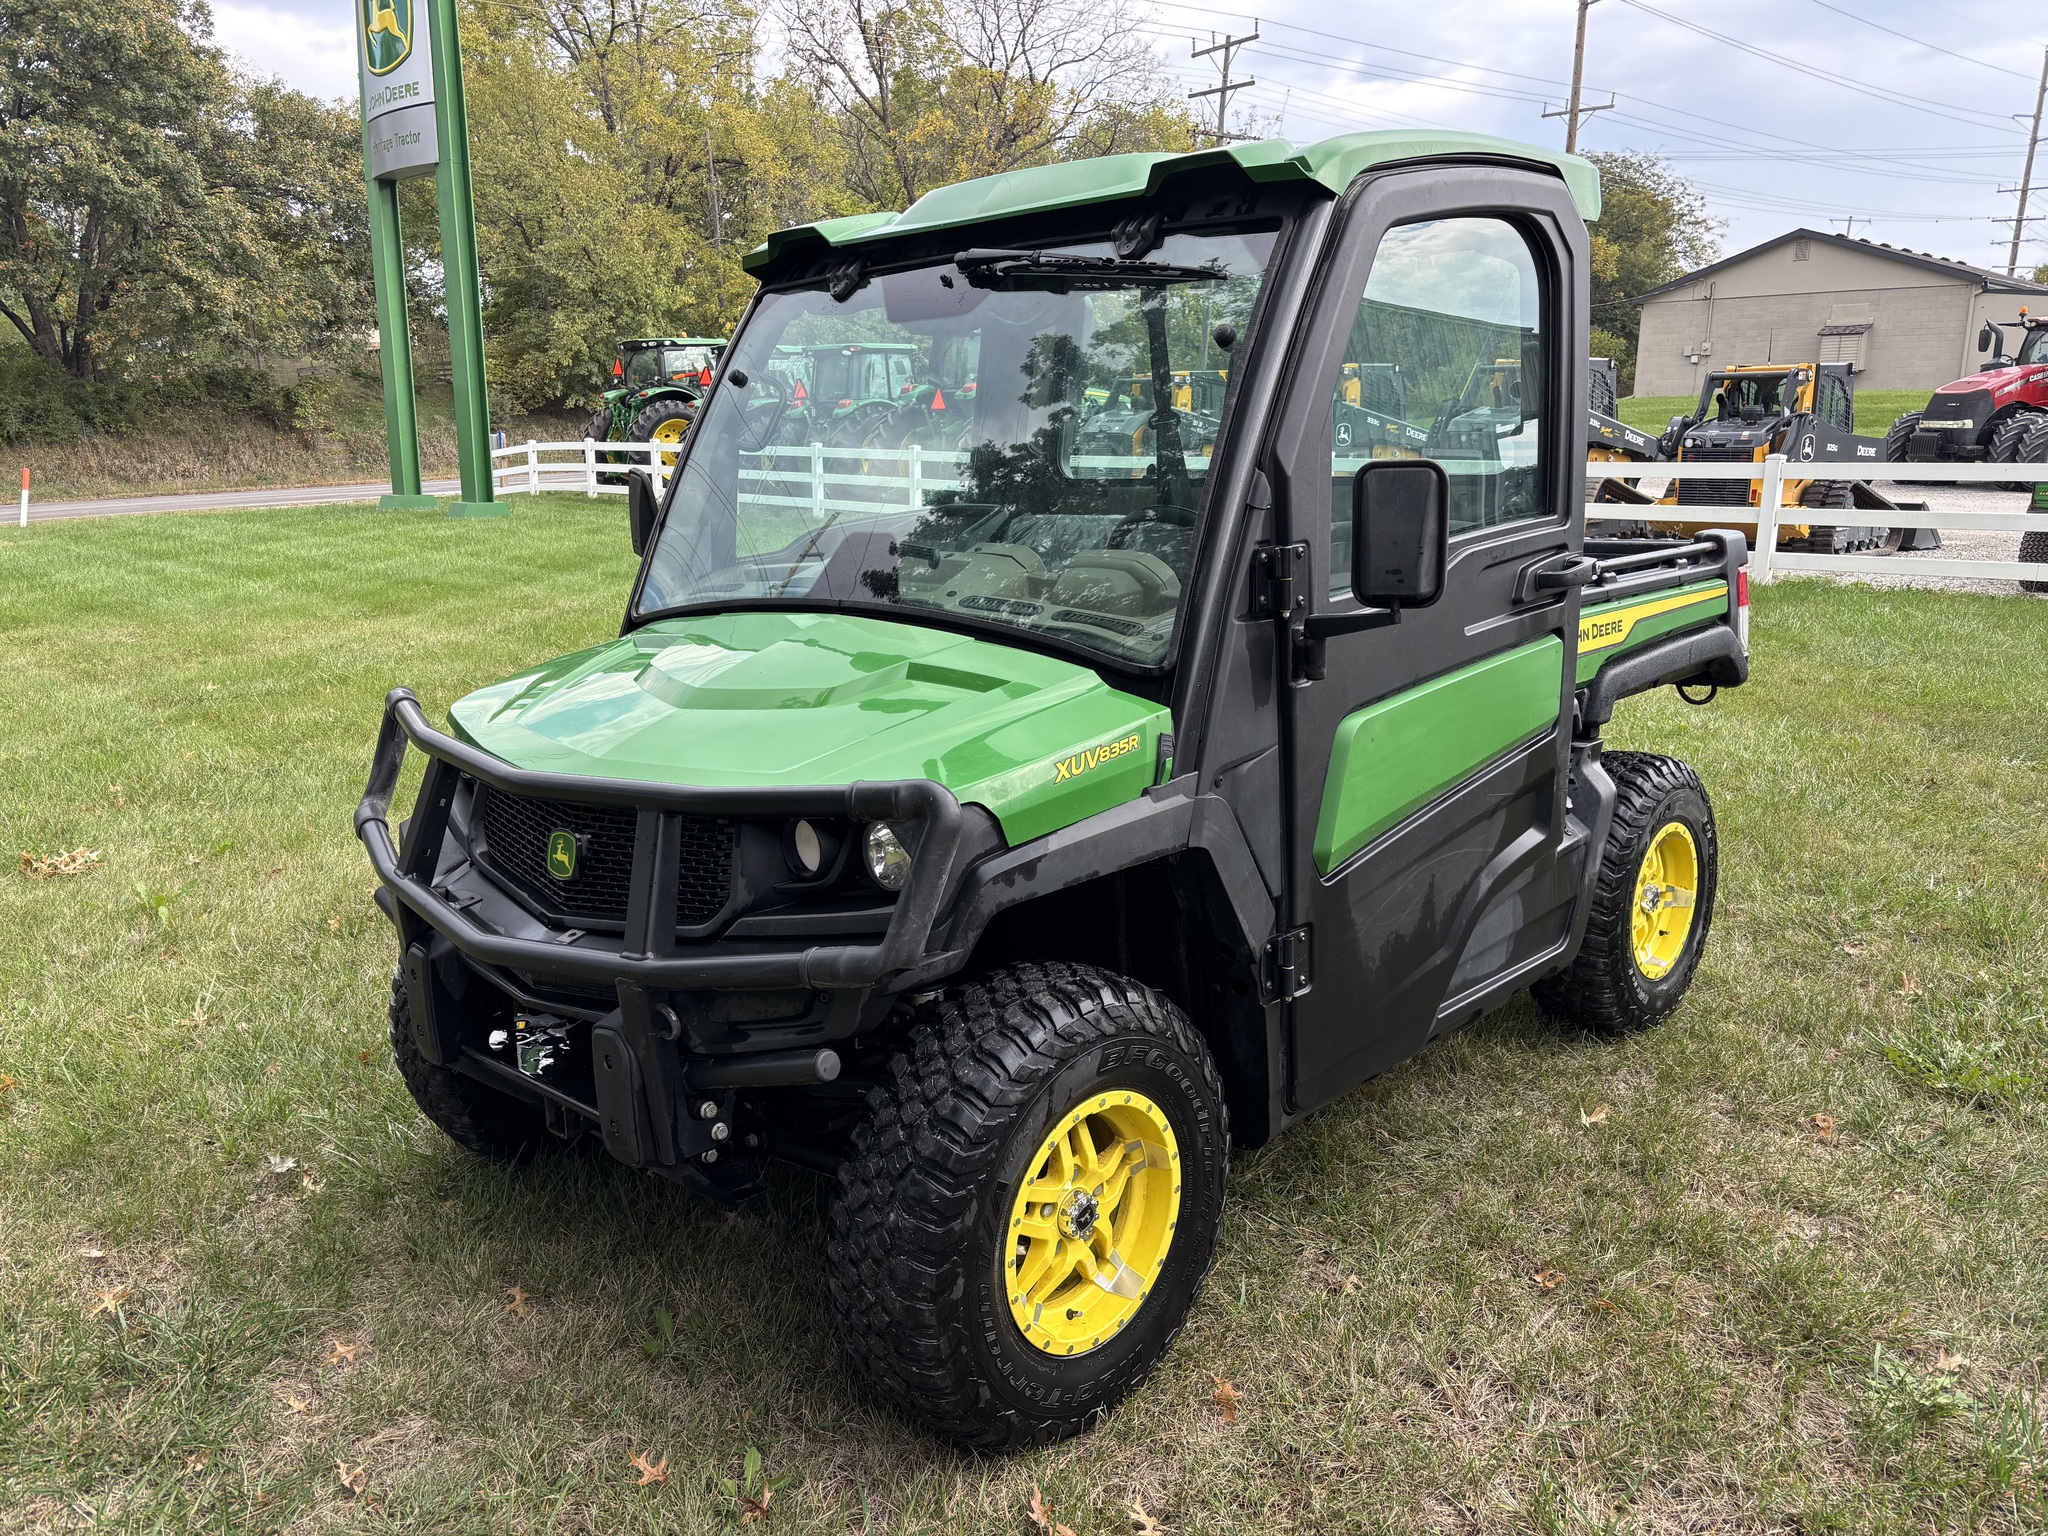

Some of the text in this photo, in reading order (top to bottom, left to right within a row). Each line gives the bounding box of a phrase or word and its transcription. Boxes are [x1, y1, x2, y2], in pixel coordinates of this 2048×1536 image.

[369, 81, 420, 112] JOHN DEERE
[394, 130, 421, 148] Tractor
[2029, 372, 2044, 381] CASE
[1405, 427, 1428, 441] DEERE
[1624, 429, 1645, 447] DEERE
[1856, 444, 1877, 457] DEERE
[1578, 620, 1623, 642] HN DEERE
[1053, 733, 1140, 785] XUV835R
[1099, 1045, 1217, 1220] BFGoodrich
